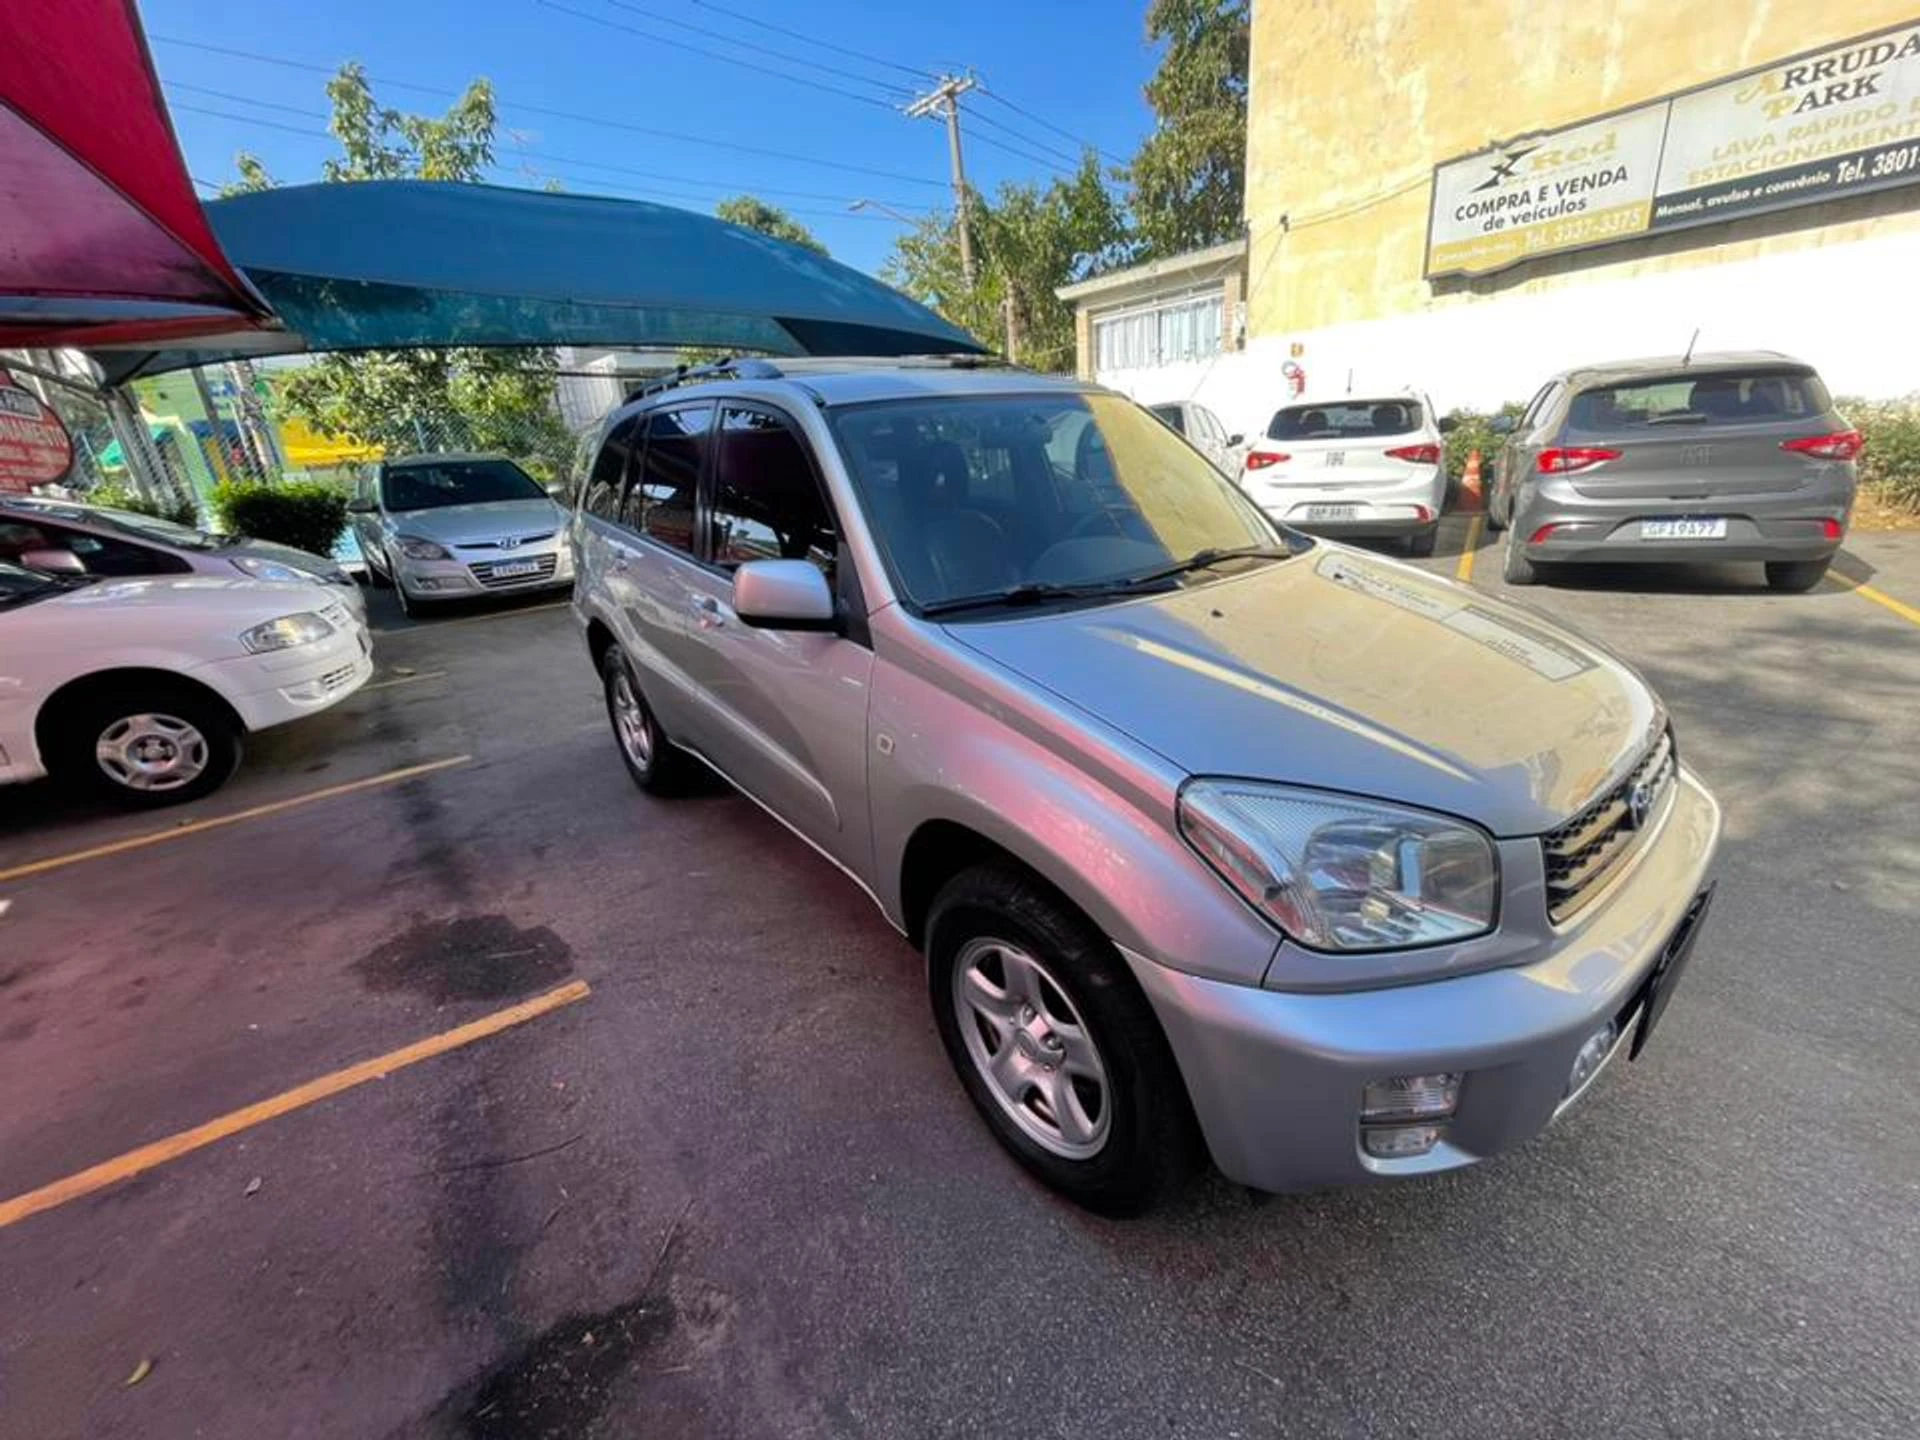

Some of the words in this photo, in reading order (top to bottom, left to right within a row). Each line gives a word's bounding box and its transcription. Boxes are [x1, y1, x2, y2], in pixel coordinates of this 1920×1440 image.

[1761, 72, 1882, 120] PARK
[1712, 133, 1776, 161] LAVA
[1837, 157, 1866, 183] Tel.
[1455, 190, 1532, 221] COMPRA
[1538, 185, 1550, 202] E
[1556, 166, 1628, 197] VENDA
[1483, 215, 1505, 232] de
[1511, 197, 1588, 225] veículos
